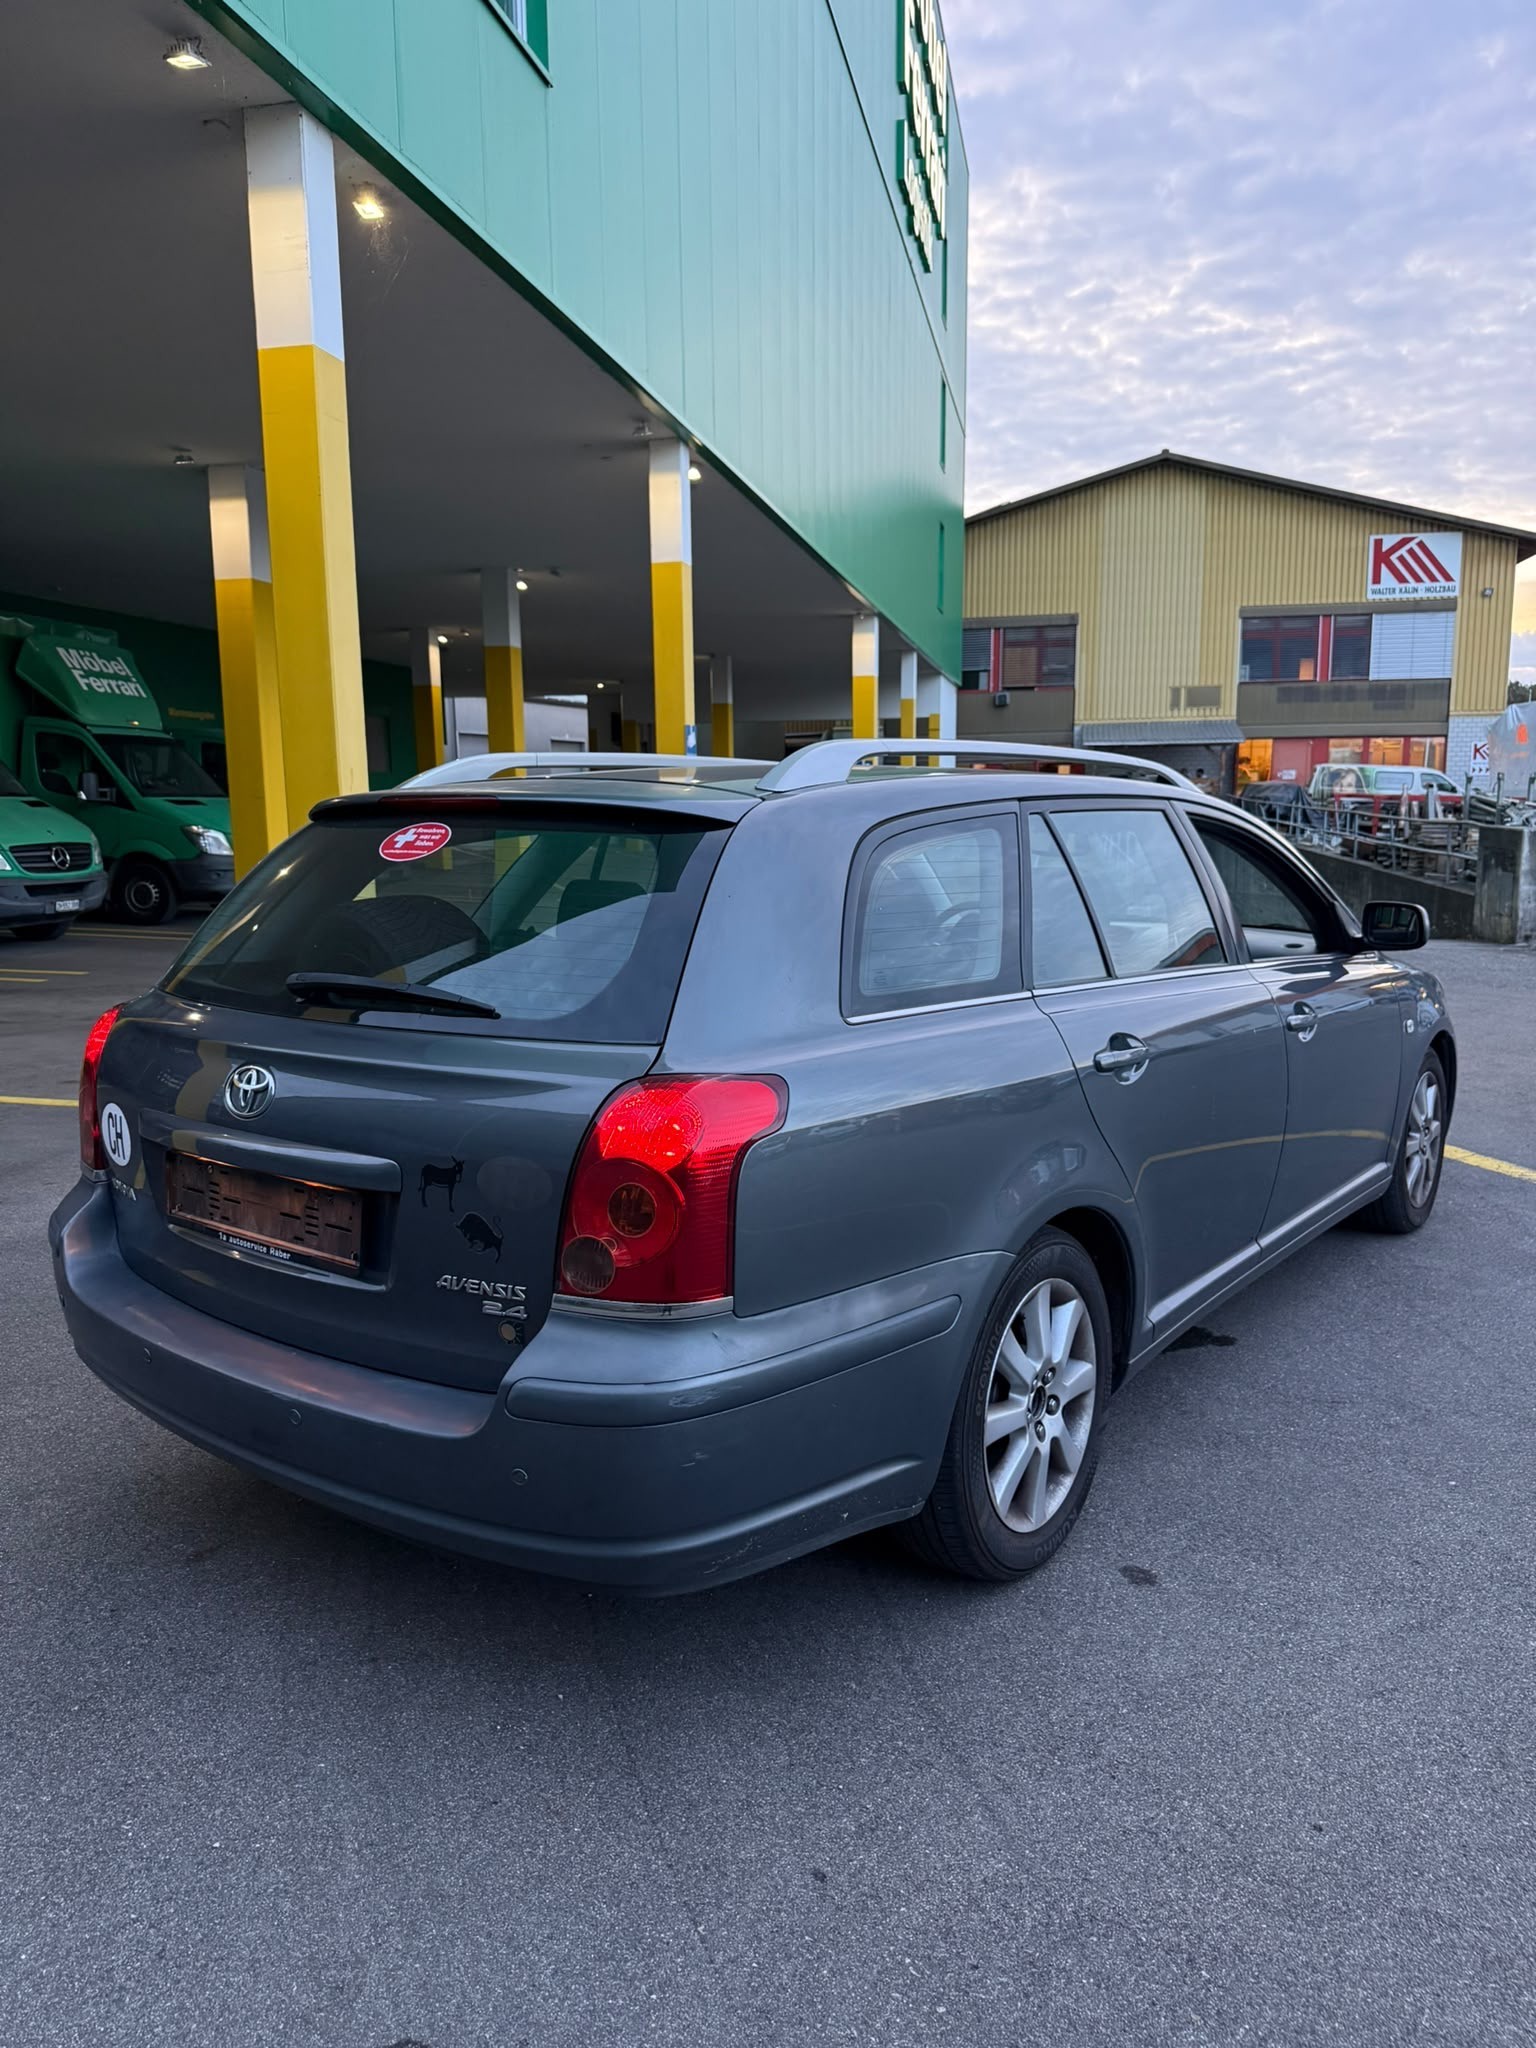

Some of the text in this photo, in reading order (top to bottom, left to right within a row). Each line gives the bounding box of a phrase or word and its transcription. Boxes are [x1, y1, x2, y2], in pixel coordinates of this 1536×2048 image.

[1370, 585, 1456, 596] WALTER KÄLIN HOLZBAU
[56, 647, 134, 677] Möbel
[71, 669, 147, 699] Ferrari
[102, 1112, 126, 1161] CH
[218, 1231, 227, 1241] 1a
[228, 1236, 267, 1254] autoservice
[436, 1274, 527, 1302] AVENSIS
[481, 1300, 528, 1320] 2.4
